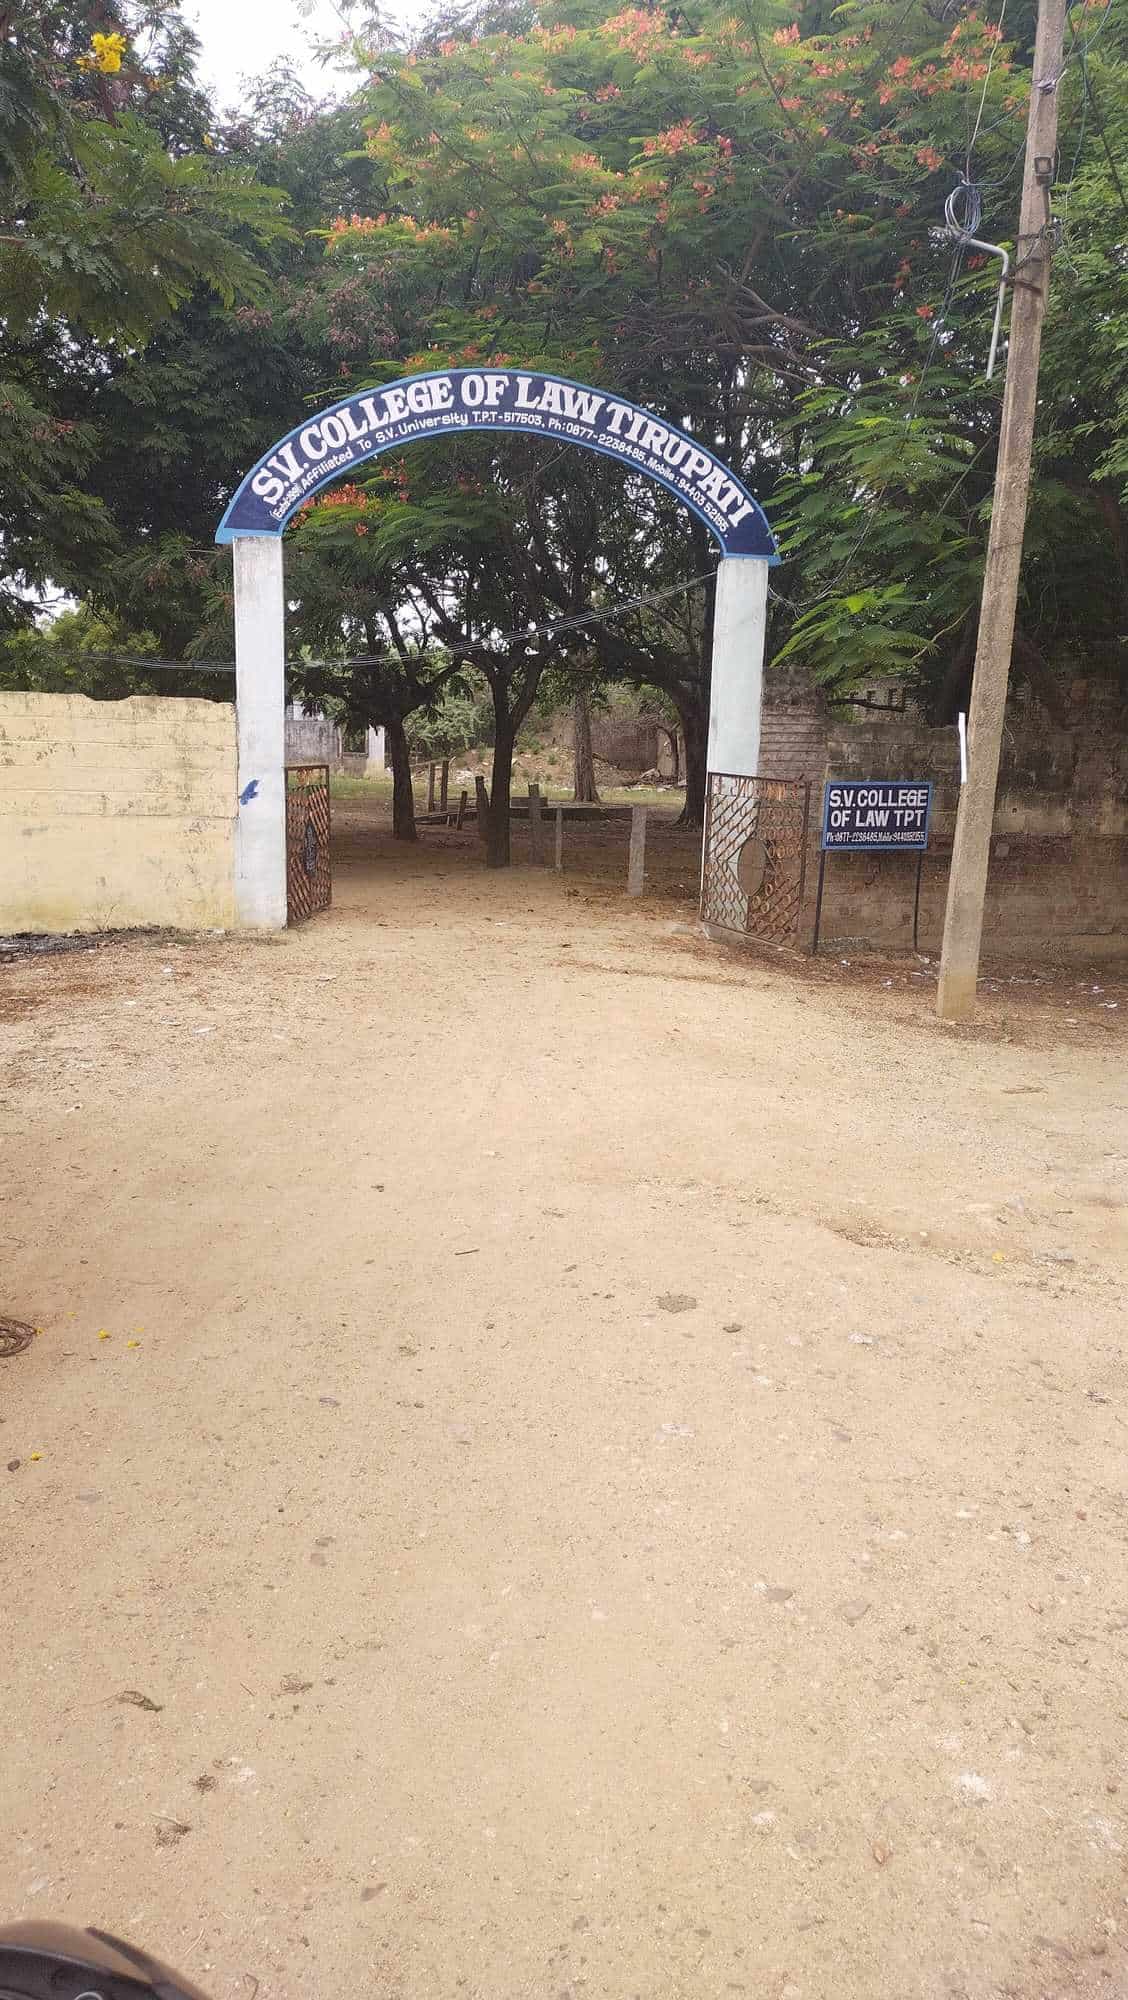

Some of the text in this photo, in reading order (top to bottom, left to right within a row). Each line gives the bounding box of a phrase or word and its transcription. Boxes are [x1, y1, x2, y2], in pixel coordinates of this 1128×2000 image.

[251, 441, 310, 505] S.V.
[299, 376, 455, 460] COLLEGE
[461, 374, 510, 407] OF
[514, 376, 606, 425] LAW
[606, 401, 754, 528] TIRUPATI
[302, 446, 354, 490] Affiliated
[356, 439, 372, 452] To
[375, 427, 399, 443] S.V.
[398, 412, 469, 436] University
[829, 789, 929, 808] S.V. COLLEGE
[830, 809, 925, 827] OF LAW TPT
